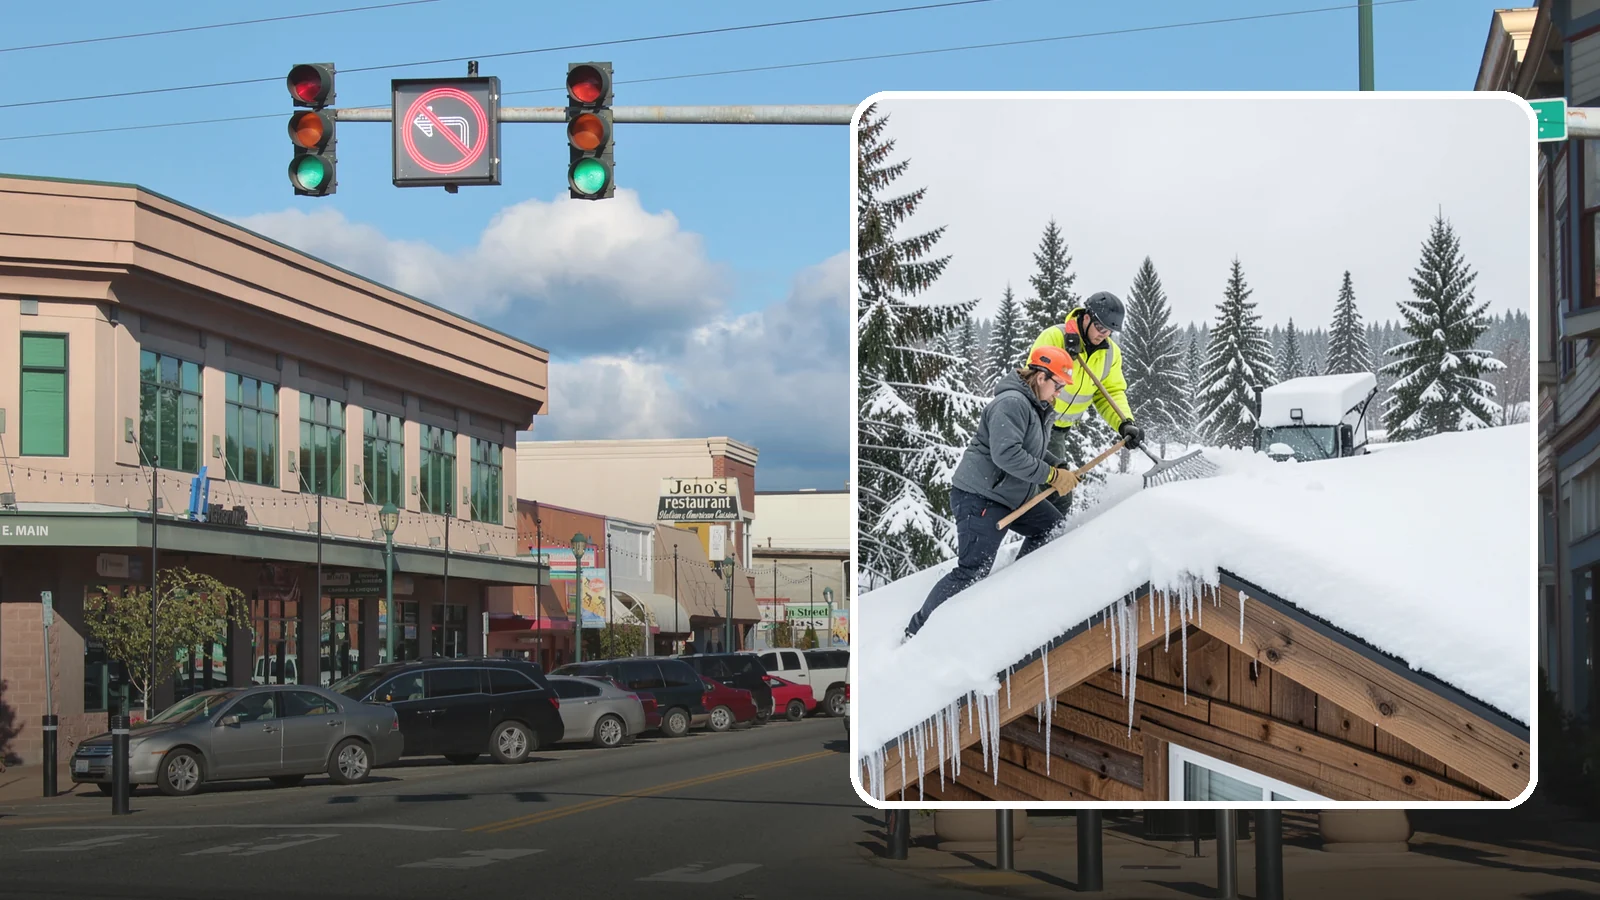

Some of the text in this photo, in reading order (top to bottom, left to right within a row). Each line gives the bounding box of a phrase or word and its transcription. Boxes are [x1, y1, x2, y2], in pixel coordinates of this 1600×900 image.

[669, 480, 728, 495] Jeno's
[665, 496, 731, 509] restaurant
[658, 510, 681, 520] Italian
[686, 510, 714, 519] American
[715, 509, 738, 519] Cuisine
[2, 525, 49, 536] E. MAIN
[797, 607, 828, 617] Street
